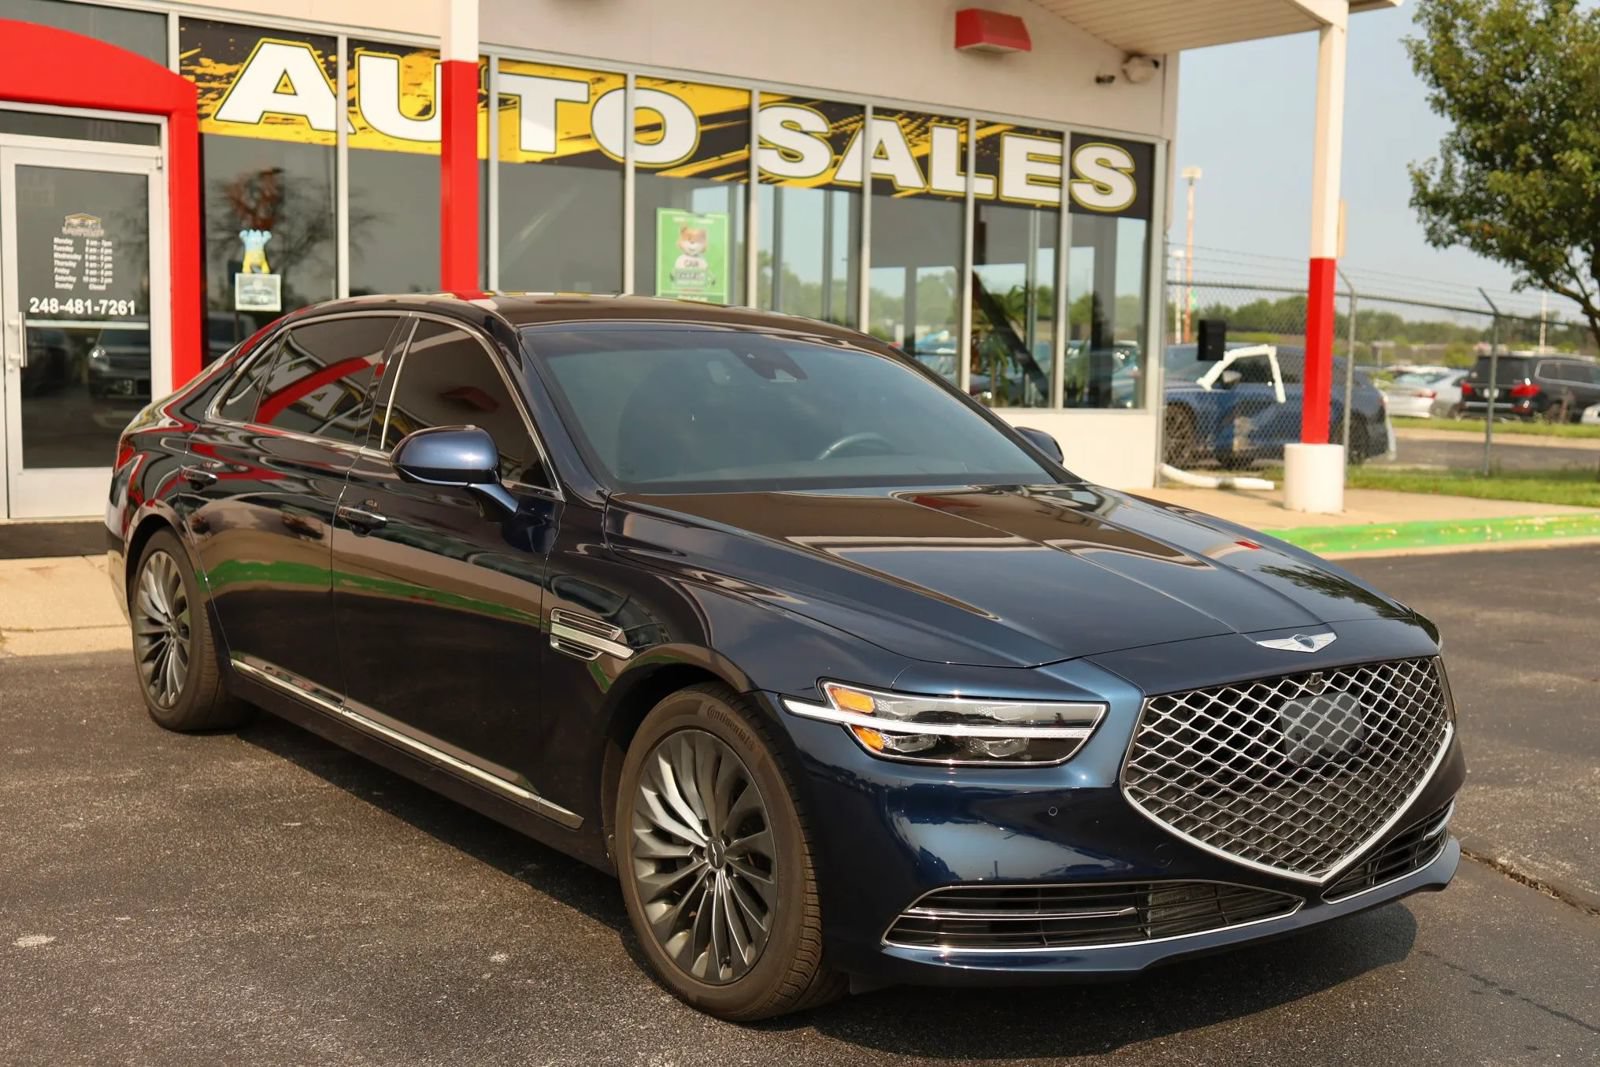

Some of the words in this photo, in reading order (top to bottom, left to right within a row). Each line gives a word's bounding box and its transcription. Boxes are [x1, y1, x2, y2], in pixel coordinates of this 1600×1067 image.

[212, 38, 700, 168] AUTO
[750, 103, 1137, 212] SALES
[29, 297, 136, 316] 248-481-7261
[706, 704, 752, 746] Continental
